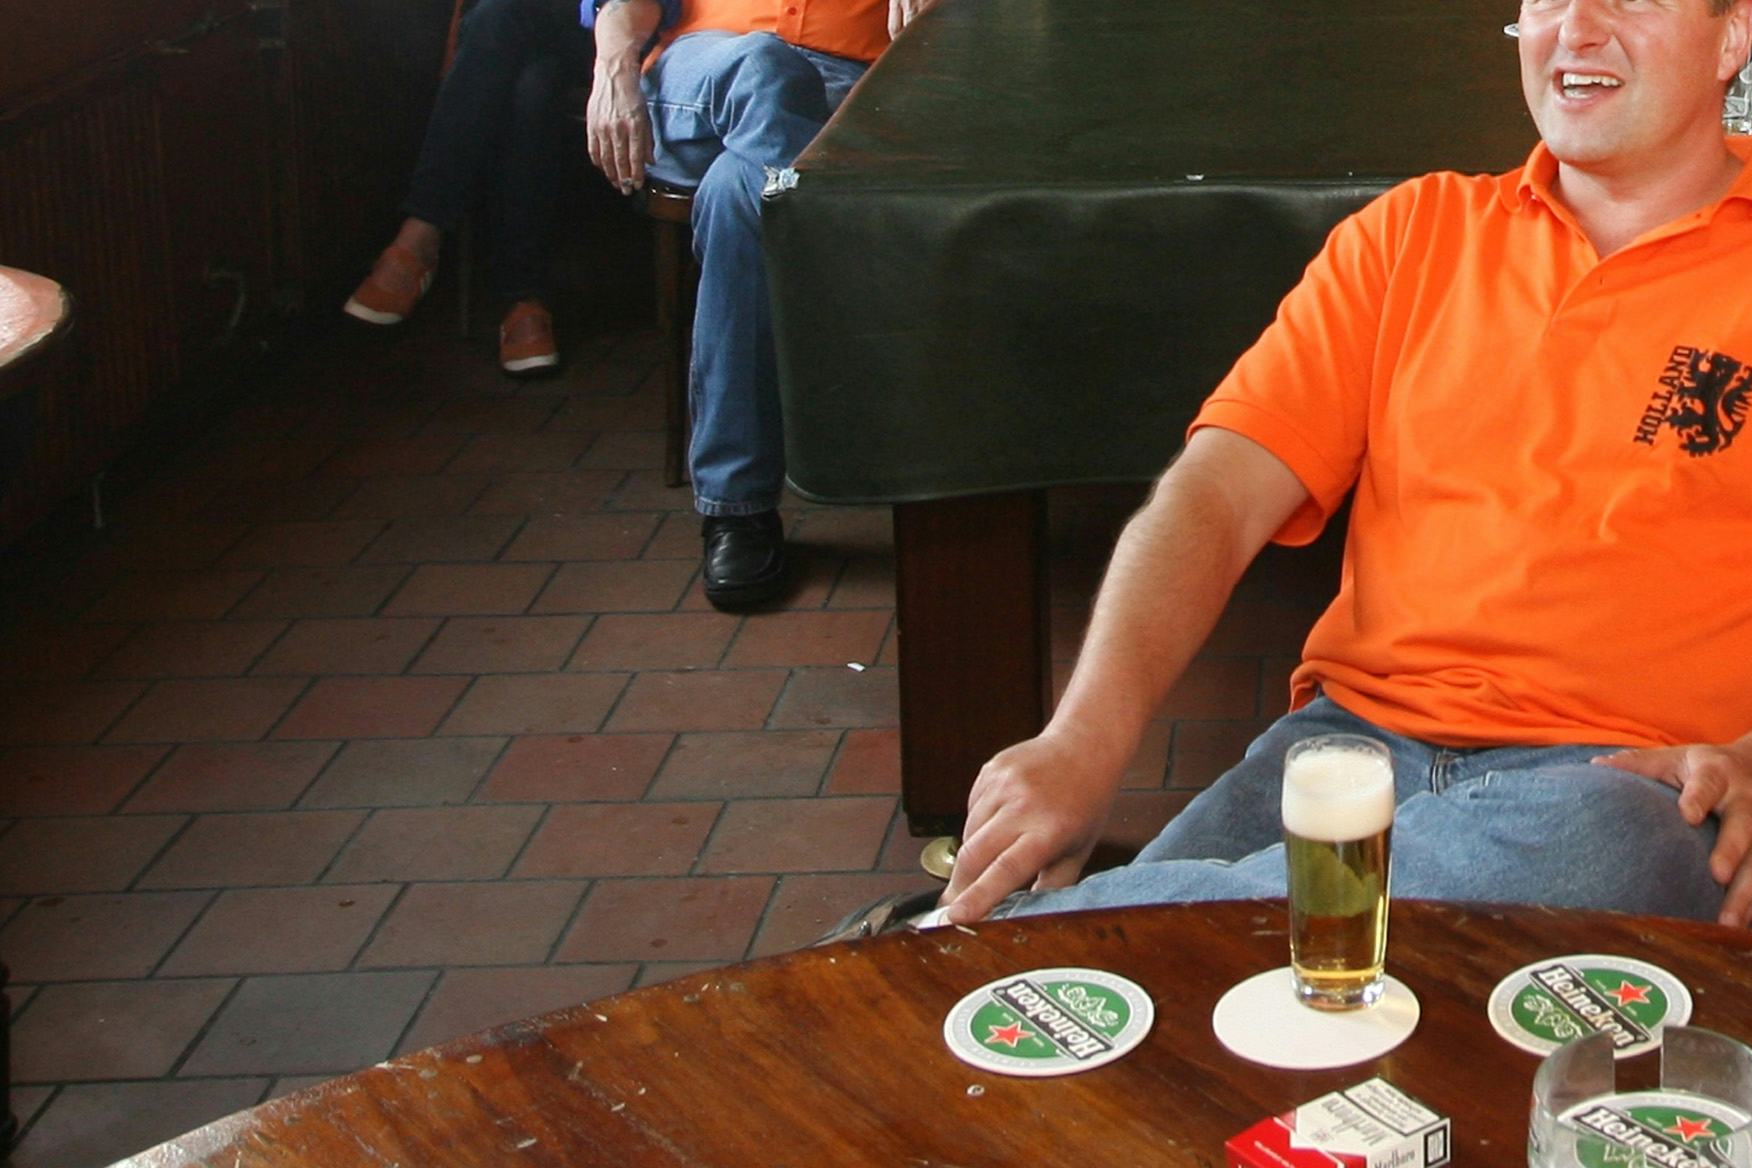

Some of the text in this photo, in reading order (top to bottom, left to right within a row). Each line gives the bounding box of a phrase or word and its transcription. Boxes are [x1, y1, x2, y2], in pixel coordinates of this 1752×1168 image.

[1633, 345, 1697, 446] HOLLAND
[1007, 982, 1105, 1058] Heineken
[1538, 965, 1636, 1047] Heineken
